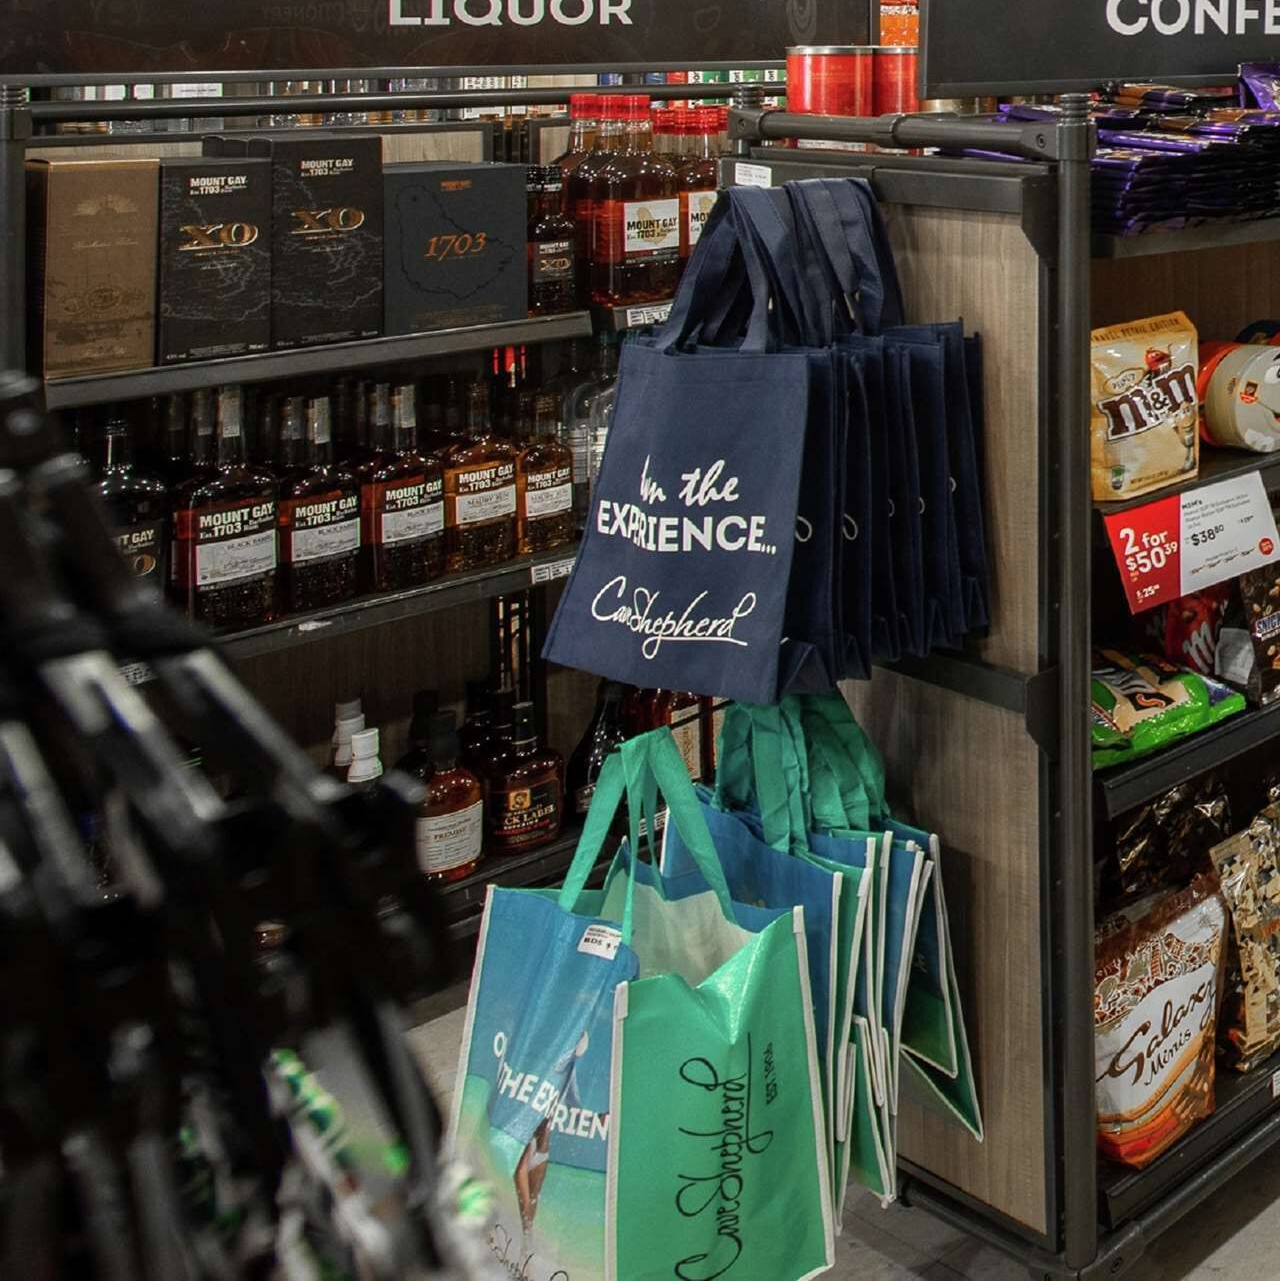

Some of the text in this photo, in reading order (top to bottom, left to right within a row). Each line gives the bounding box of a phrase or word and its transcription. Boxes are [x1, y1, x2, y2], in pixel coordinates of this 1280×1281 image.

[301, 158, 354, 169] MOUNT GAY
[190, 175, 247, 187] MOUNT GAY
[291, 207, 365, 234] XO
[627, 218, 677, 230] MOUNT GAY
[179, 222, 258, 250] XO
[424, 233, 486, 261] 1703
[459, 464, 514, 484] MOUNT GAY
[469, 479, 490, 491] 1703
[528, 467, 570, 483] MOUNT GAY
[679, 459, 740, 506] the
[386, 480, 442, 501] MOUNT GAY
[200, 502, 273, 528] MOUNT GAY
[296, 495, 357, 518] MOUNT GAY
[213, 522, 241, 537] 1703
[307, 513, 330, 526] 1703
[132, 529, 154, 544] GAY
[1120, 527, 1167, 555] 2 for
[1096, 980, 1215, 1086] Galaxy
[1145, 1028, 1192, 1085] Minis
[499, 1062, 539, 1104] THE
